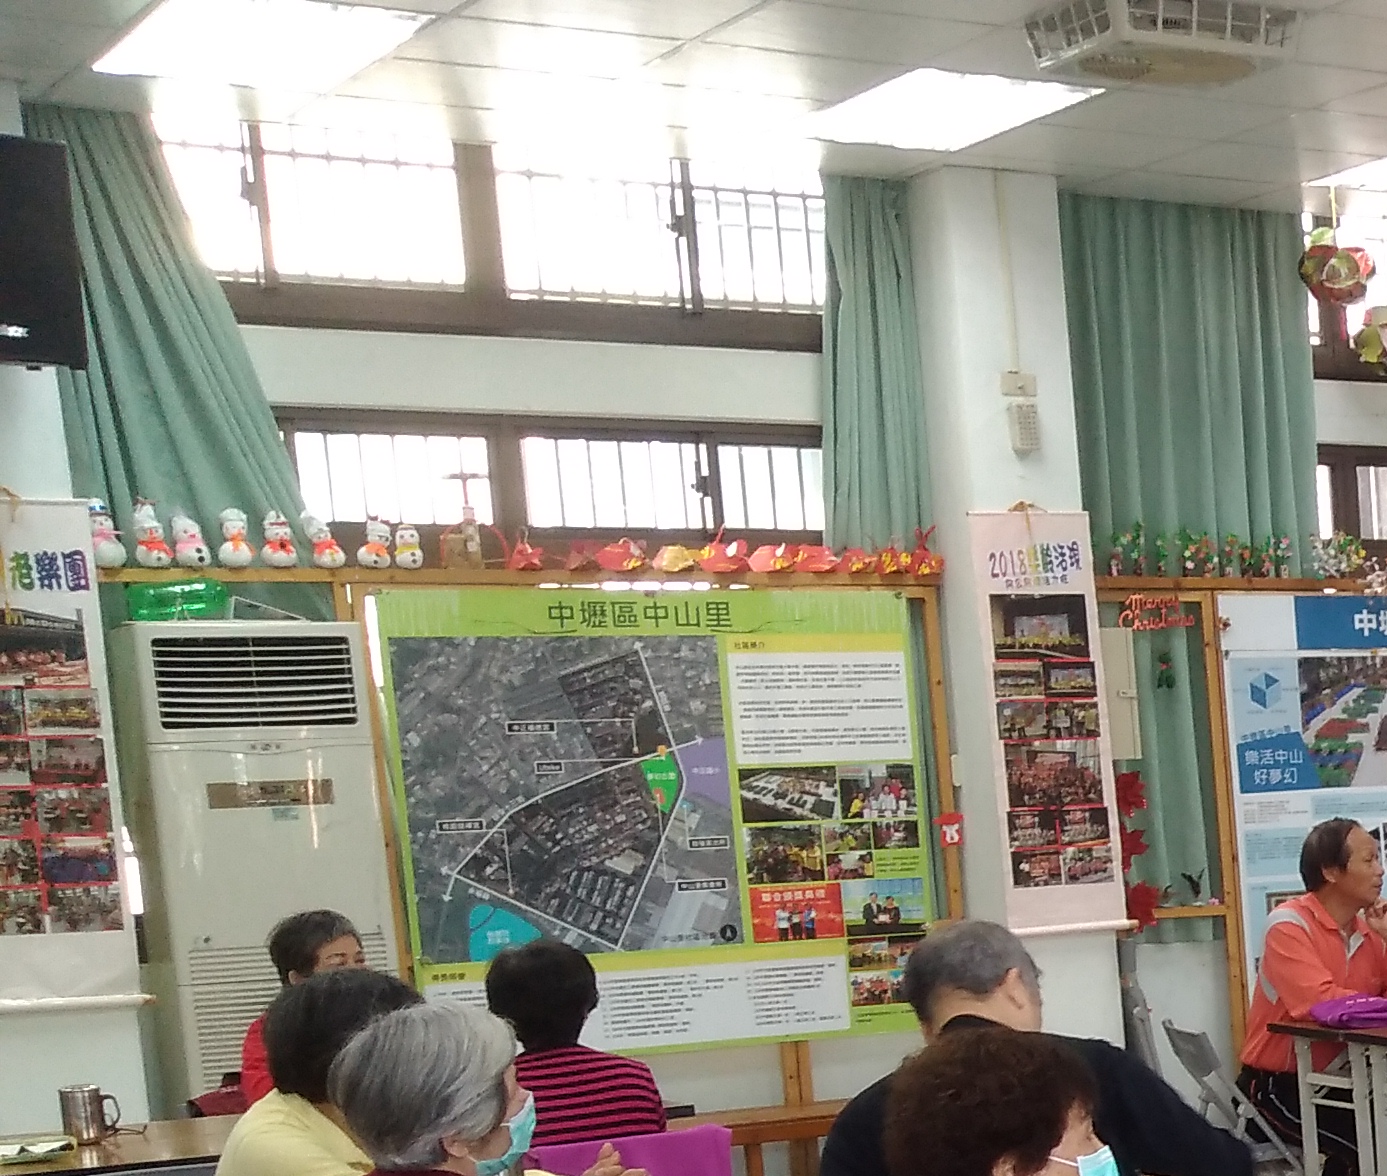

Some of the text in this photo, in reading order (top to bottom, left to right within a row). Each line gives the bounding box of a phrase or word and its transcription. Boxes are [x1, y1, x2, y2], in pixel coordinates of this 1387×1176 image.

[548, 600, 733, 629] 中壢區中山里
[1244, 748, 1304, 766] 樂活中山
[1254, 767, 1299, 785] 好夢幻
